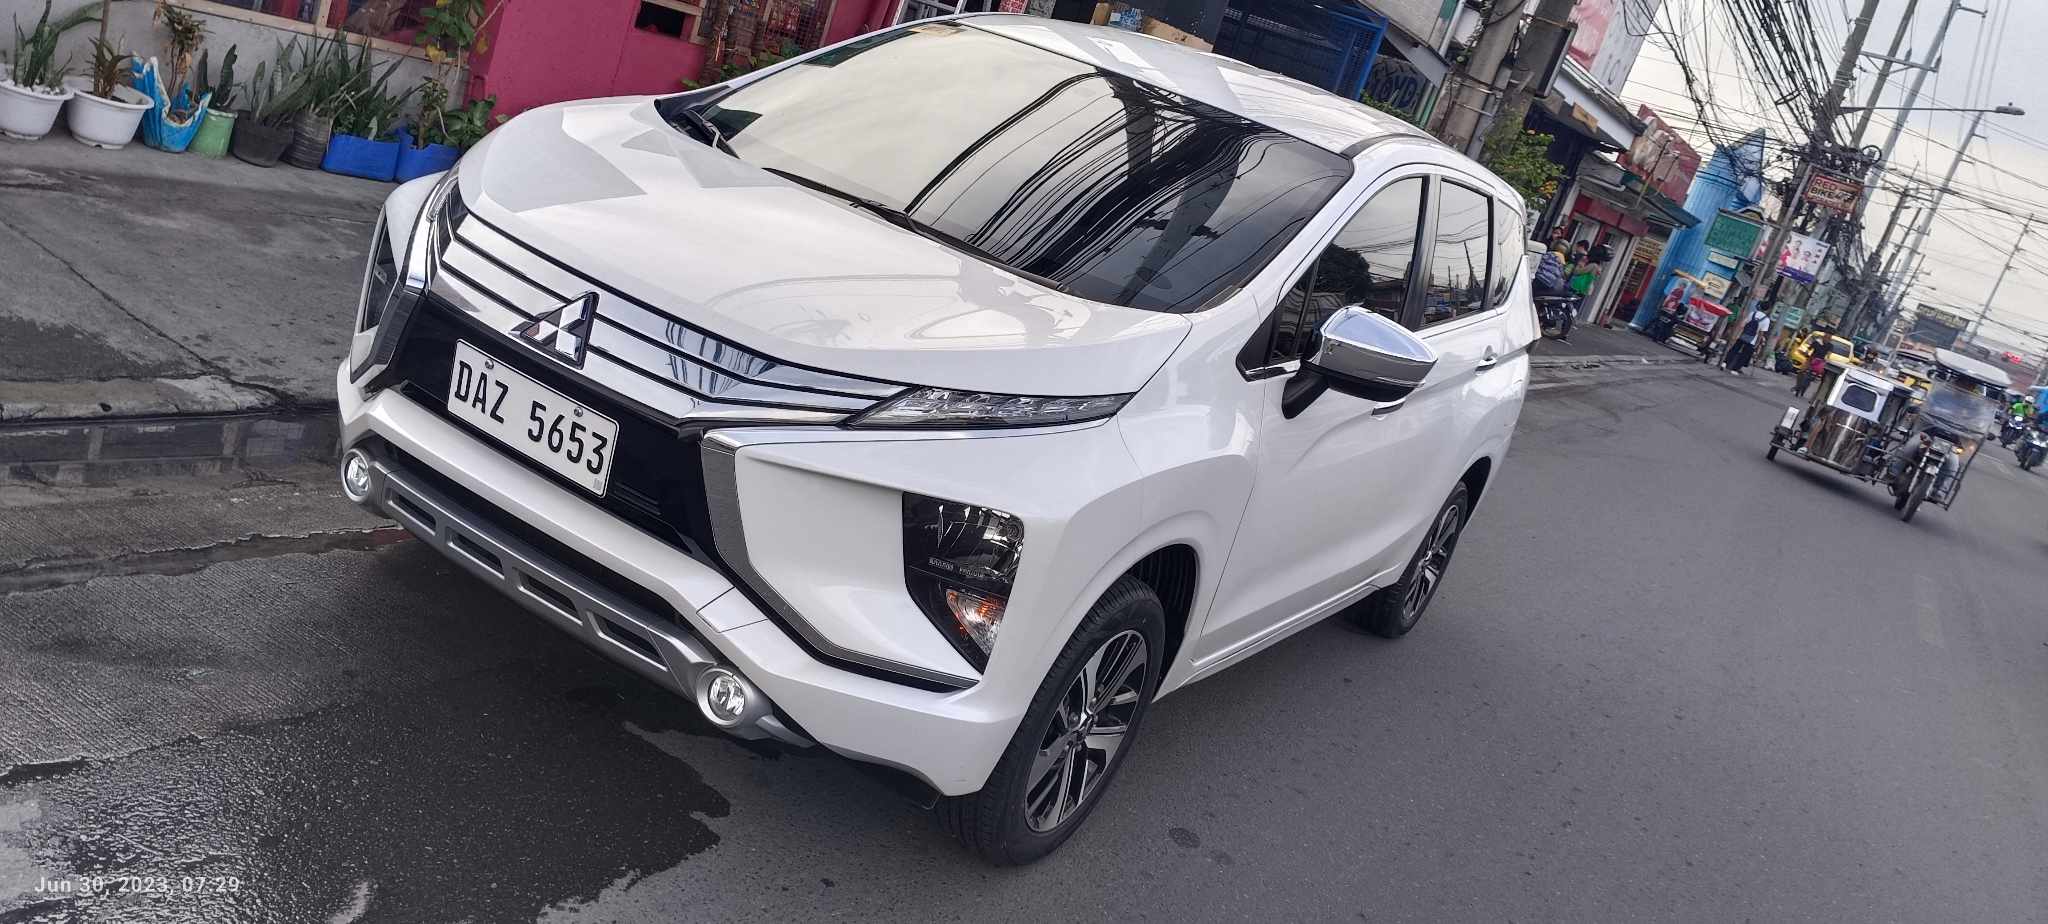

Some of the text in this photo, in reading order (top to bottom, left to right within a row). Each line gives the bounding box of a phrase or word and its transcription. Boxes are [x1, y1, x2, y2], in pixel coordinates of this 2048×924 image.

[1814, 178, 1837, 191] RED
[455, 360, 608, 475] DAZ 5653
